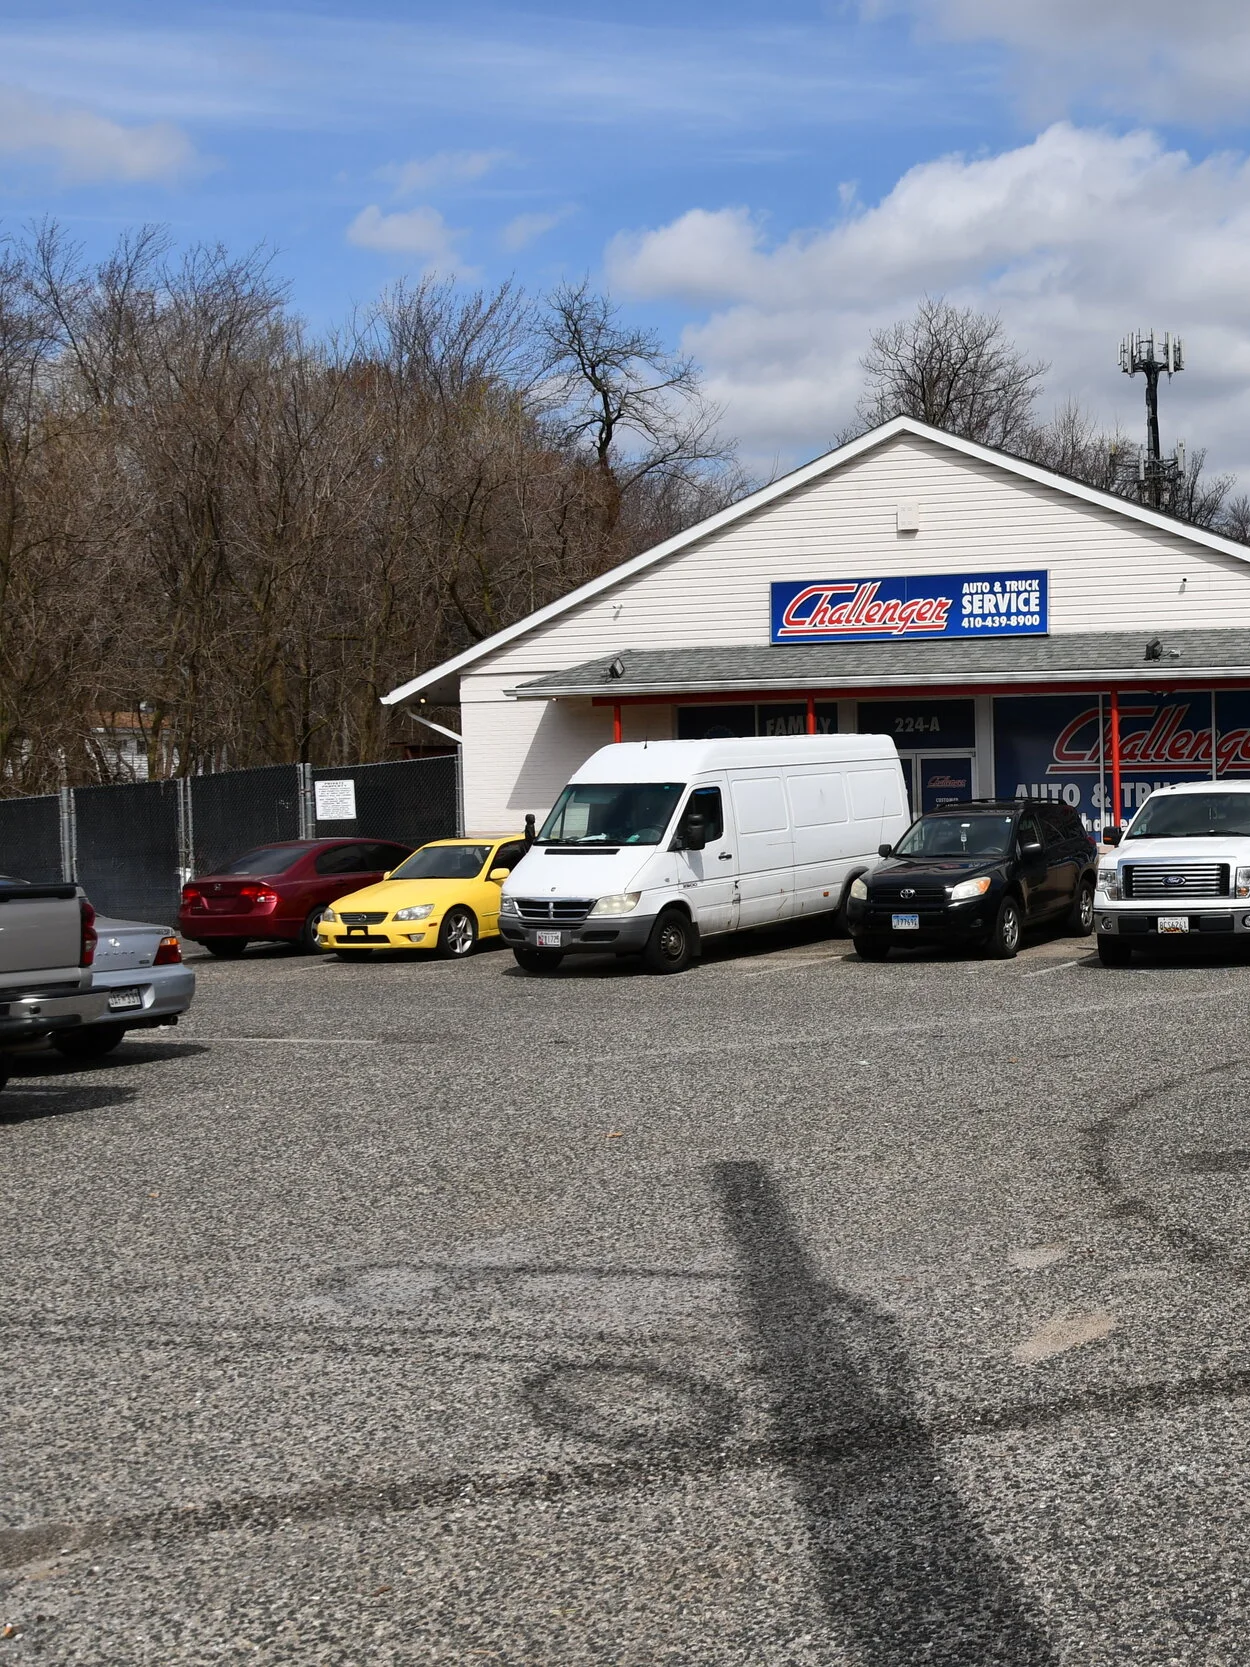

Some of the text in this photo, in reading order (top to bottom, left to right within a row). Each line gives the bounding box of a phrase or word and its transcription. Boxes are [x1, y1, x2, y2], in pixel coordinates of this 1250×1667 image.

[962, 580, 1040, 594] AUTO & TRUCK
[778, 581, 953, 636] Challenger
[961, 592, 1040, 615] SERVICE
[961, 615, 1040, 628] 410-439-8900
[895, 716, 940, 732] 224-A
[1014, 783, 1080, 808] AUTO
[1091, 782, 1111, 808] &
